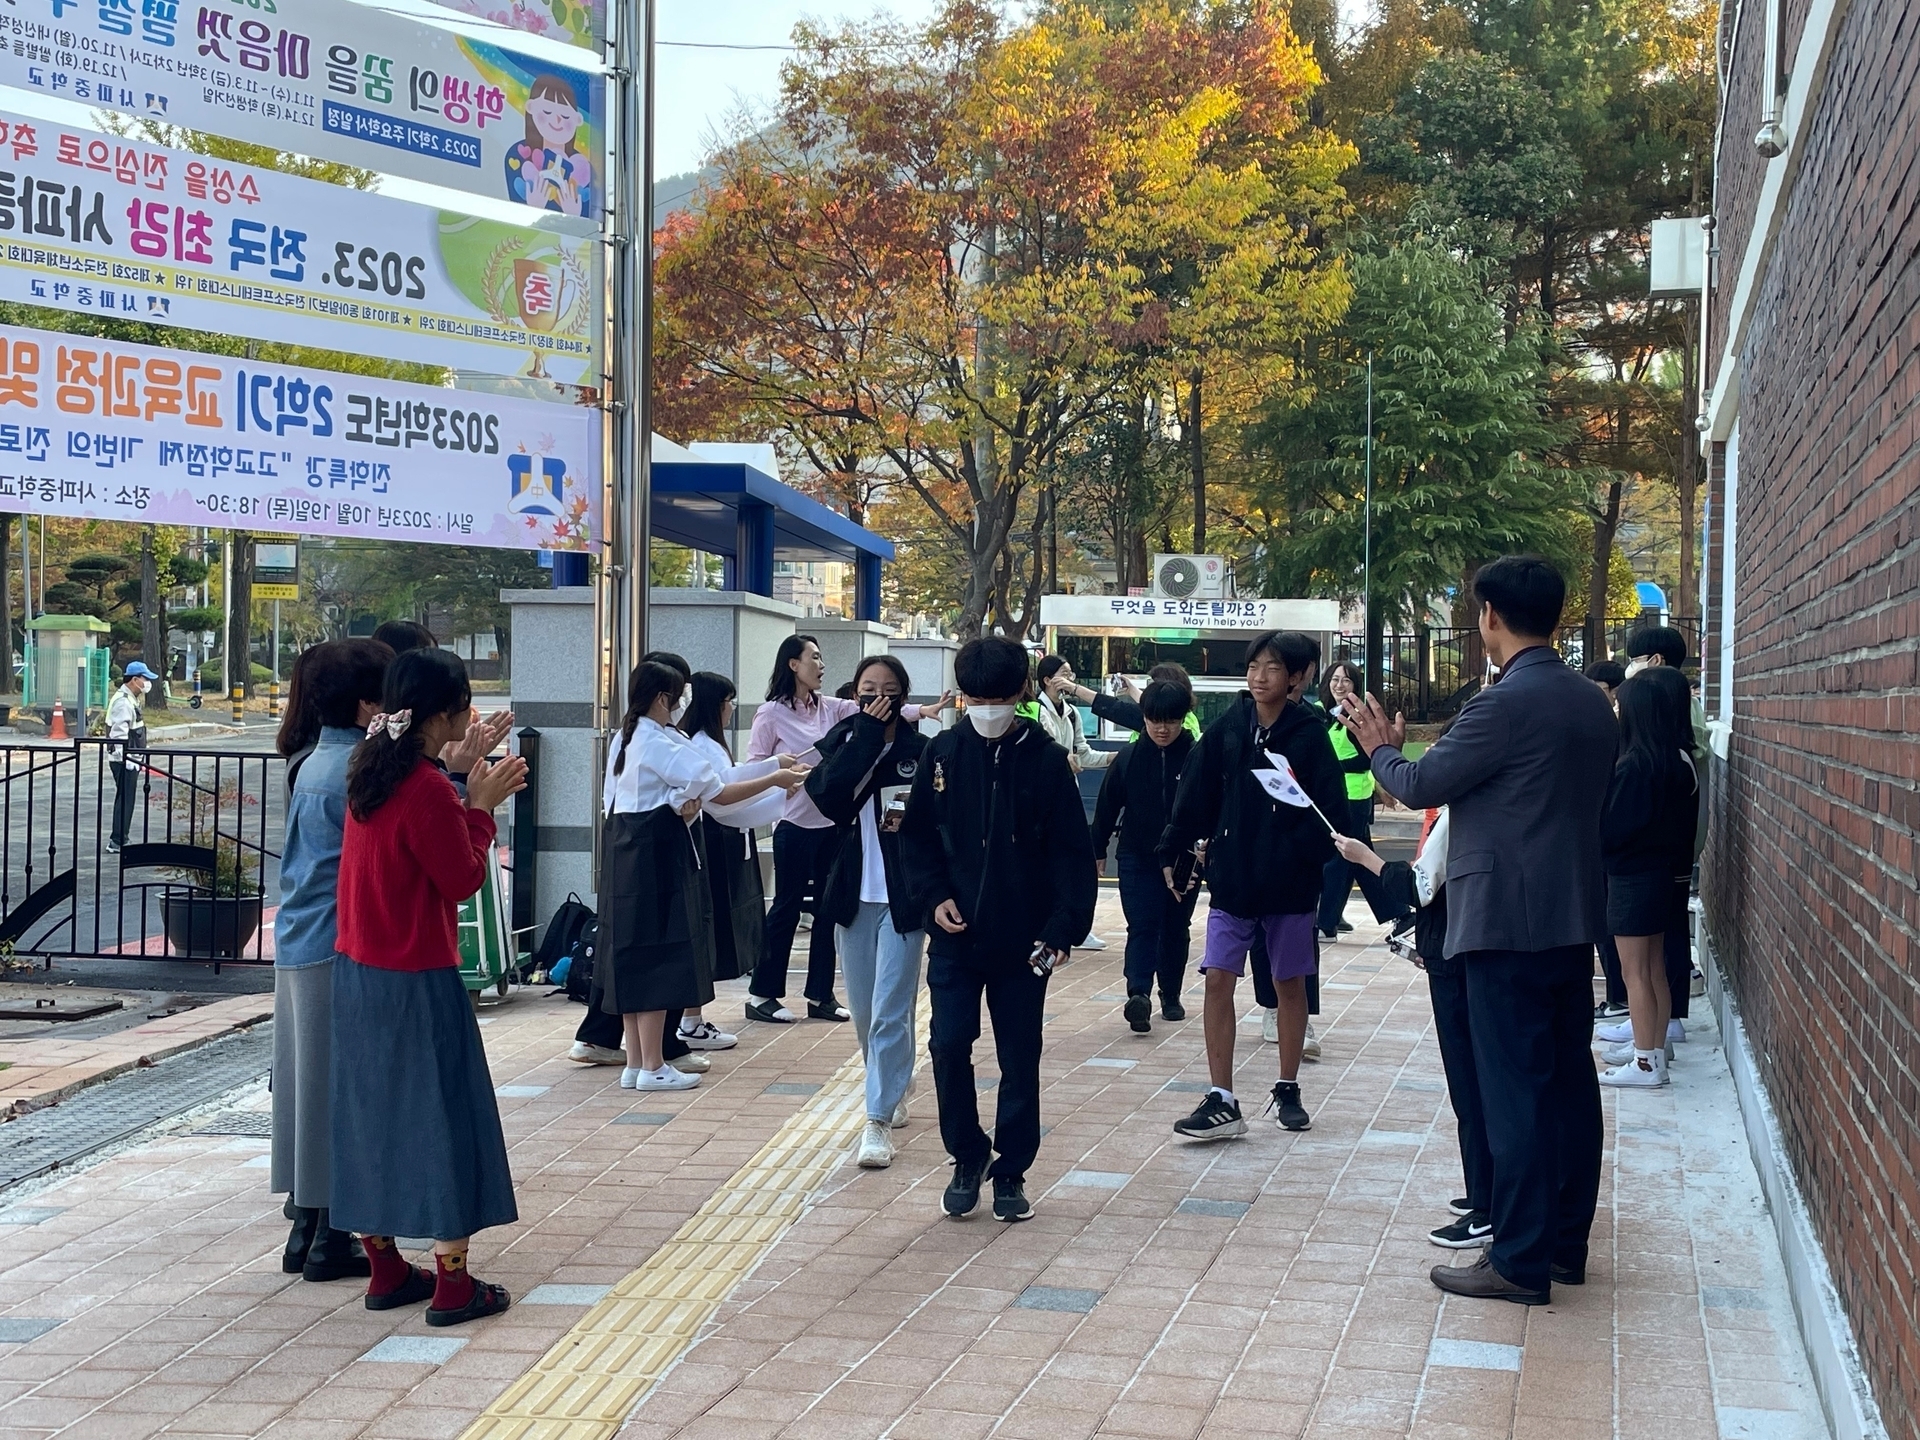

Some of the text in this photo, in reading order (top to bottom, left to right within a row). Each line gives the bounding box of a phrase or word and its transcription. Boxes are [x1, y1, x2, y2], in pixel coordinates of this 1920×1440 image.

[1111, 600, 1267, 617] 무엇을 도와드릴까요?
[1183, 617, 1204, 626] May
[1213, 617, 1236, 627] help
[1240, 618, 1265, 627] you?
